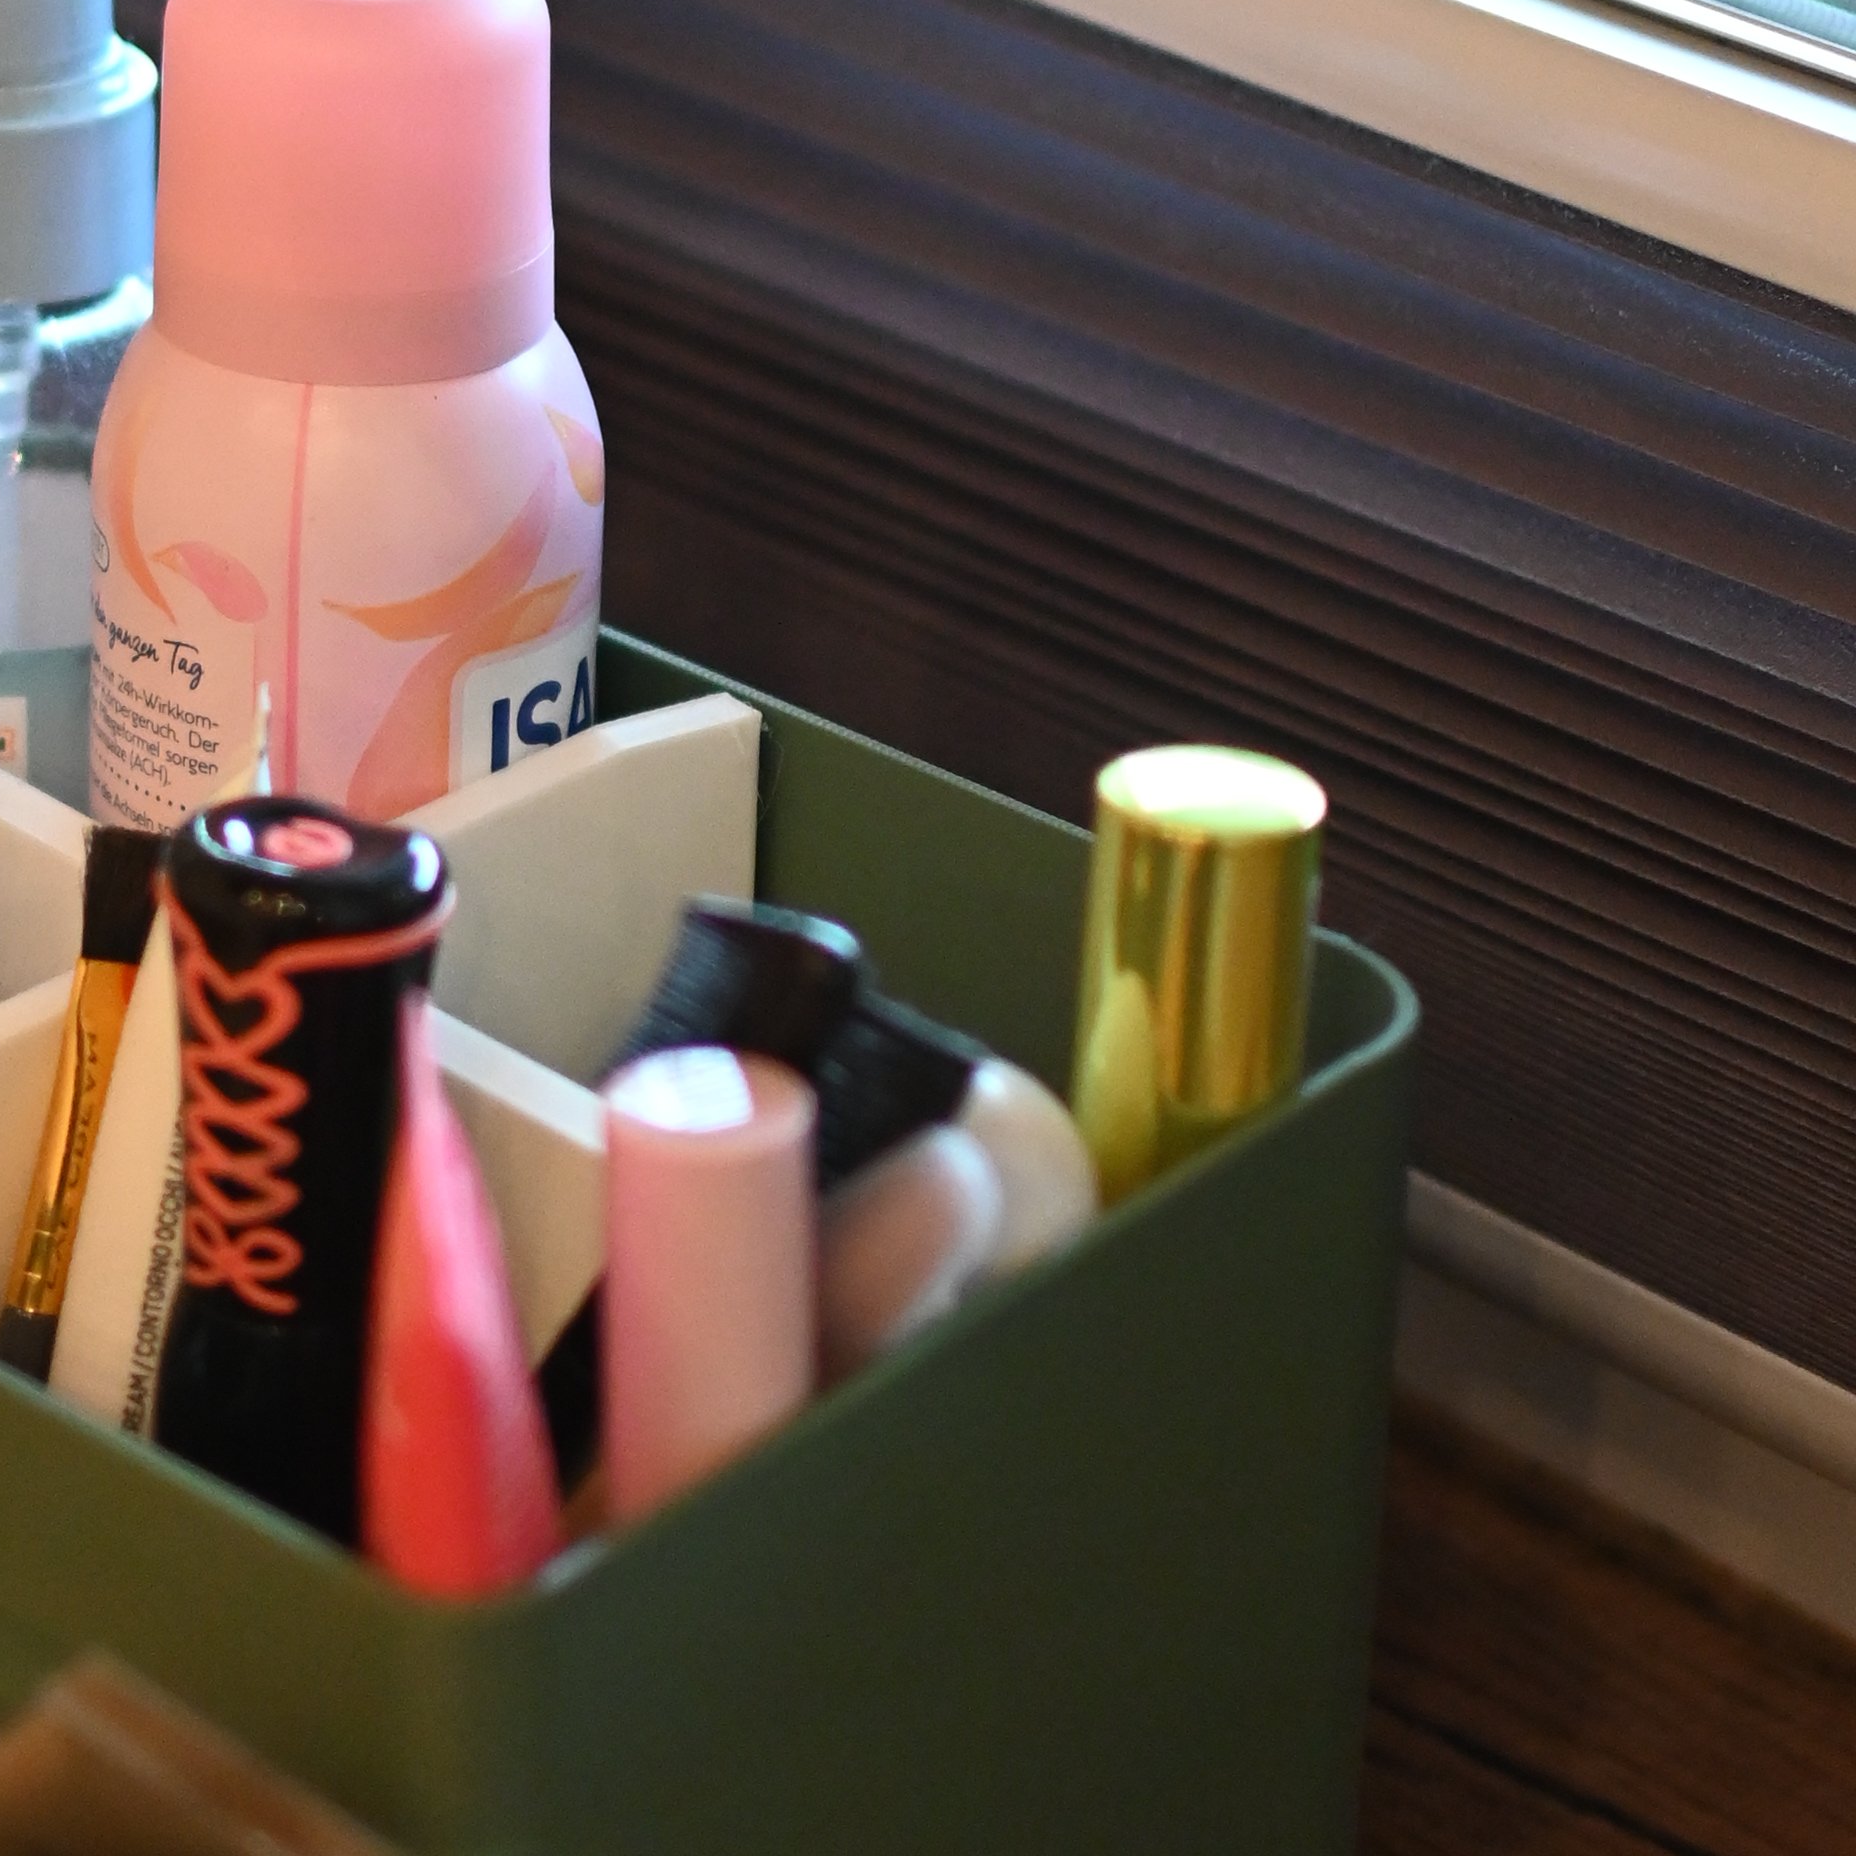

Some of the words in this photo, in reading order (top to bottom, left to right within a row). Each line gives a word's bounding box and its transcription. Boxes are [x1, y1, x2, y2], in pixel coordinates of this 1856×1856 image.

[163, 639, 204, 690] Tag
[491, 656, 592, 773] ISA
[165, 749, 218, 775] sorgen
[189, 730, 219, 753] Der
[134, 1244, 173, 1359] CONTORNO
